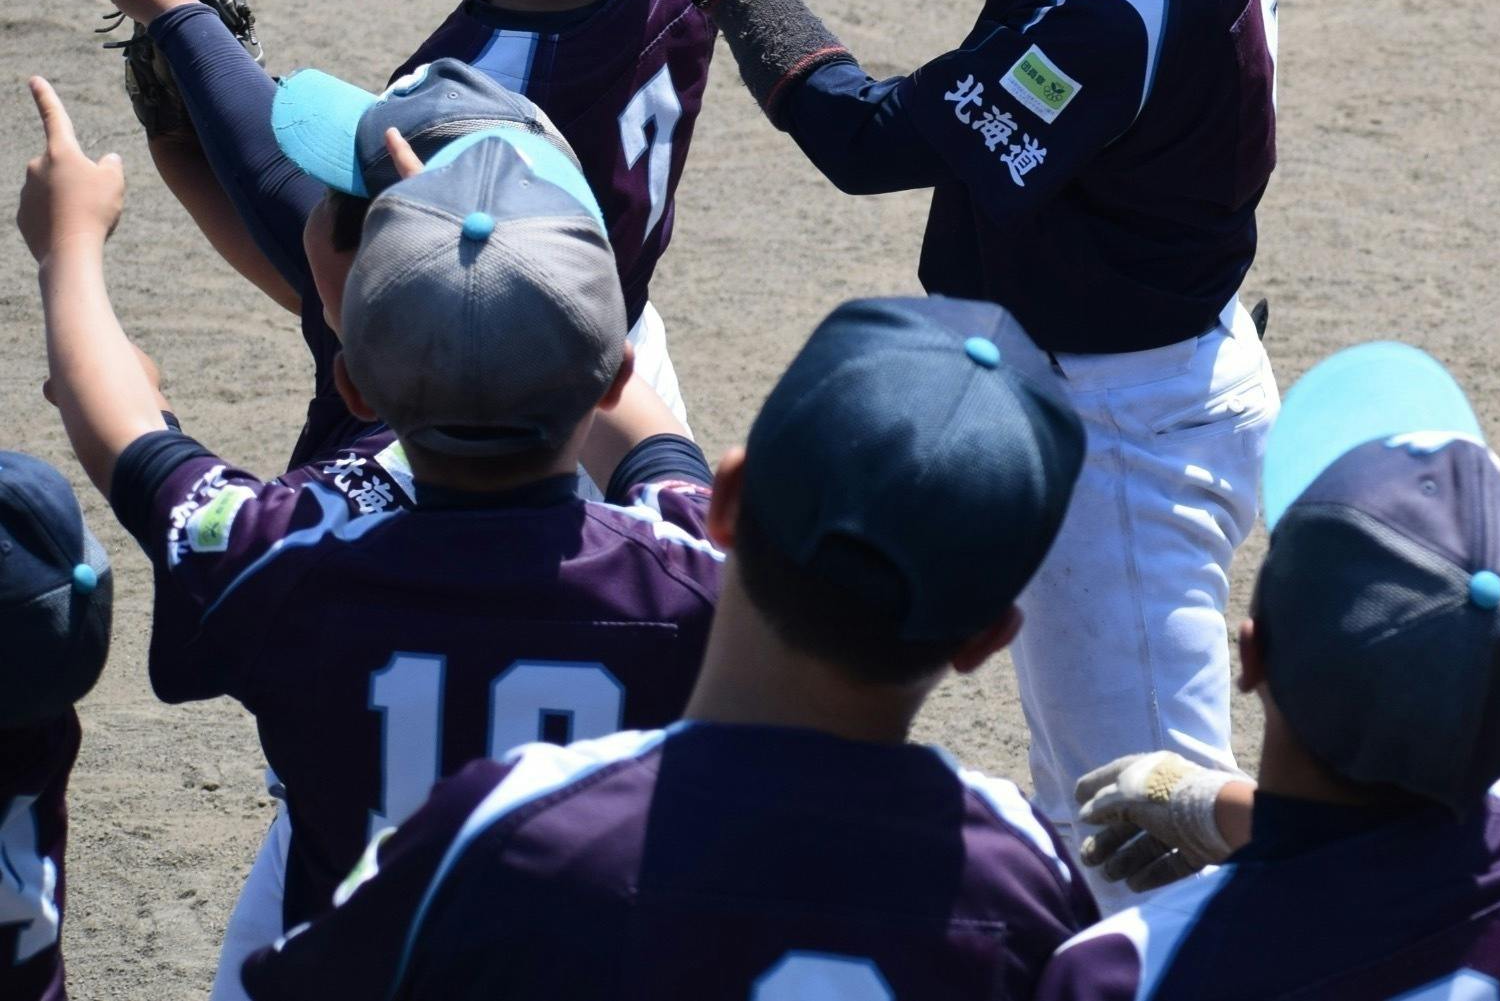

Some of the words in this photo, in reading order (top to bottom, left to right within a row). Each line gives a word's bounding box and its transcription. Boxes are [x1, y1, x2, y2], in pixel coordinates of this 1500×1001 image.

[618, 63, 682, 244] 7
[944, 74, 1047, 187] 北海道
[323, 452, 394, 514] 北海
